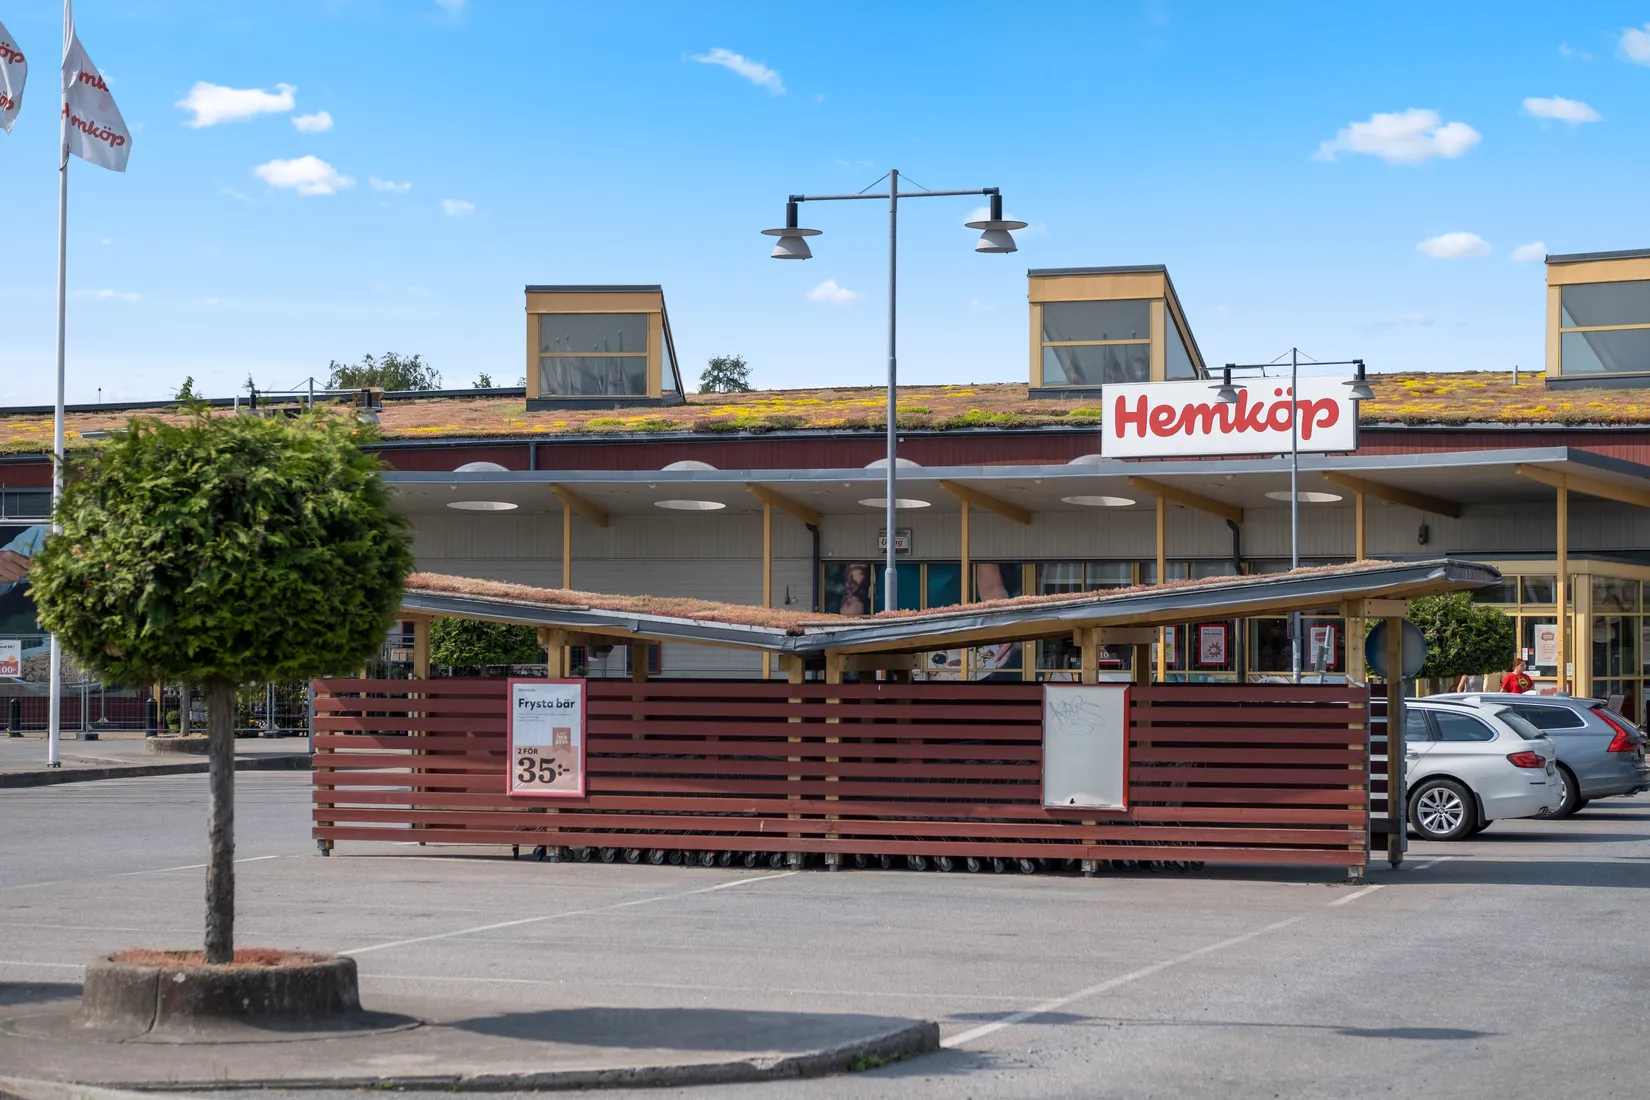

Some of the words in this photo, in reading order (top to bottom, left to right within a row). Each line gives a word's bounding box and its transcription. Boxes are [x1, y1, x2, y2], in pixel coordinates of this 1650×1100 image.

[1115, 387, 1339, 440] Hemköp
[518, 698, 554, 711] Frysta
[556, 697, 575, 708] bär
[523, 747, 539, 755] FÖR
[517, 757, 570, 784] 35:-
